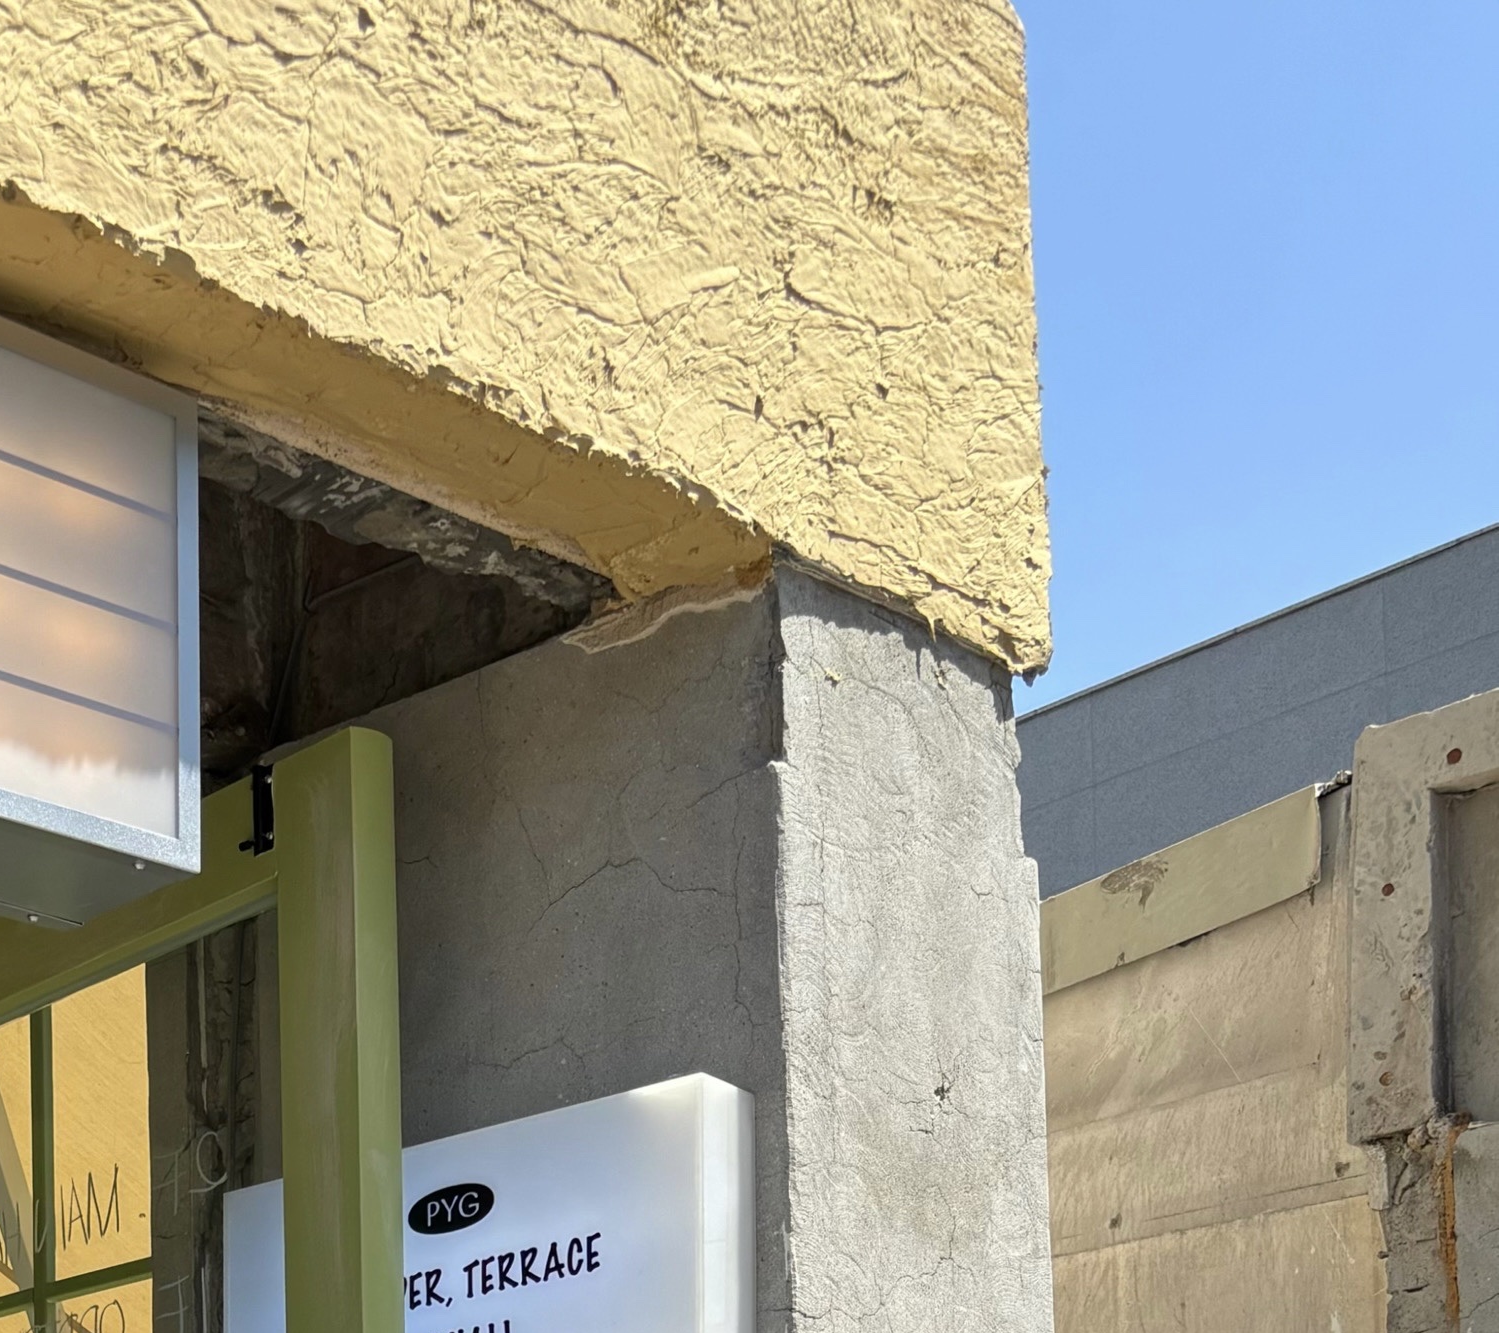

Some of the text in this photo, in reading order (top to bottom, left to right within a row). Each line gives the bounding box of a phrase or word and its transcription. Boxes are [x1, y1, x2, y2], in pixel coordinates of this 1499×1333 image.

[426, 1191, 481, 1228] PYG
[403, 1232, 602, 1311] ER, TERRACE
